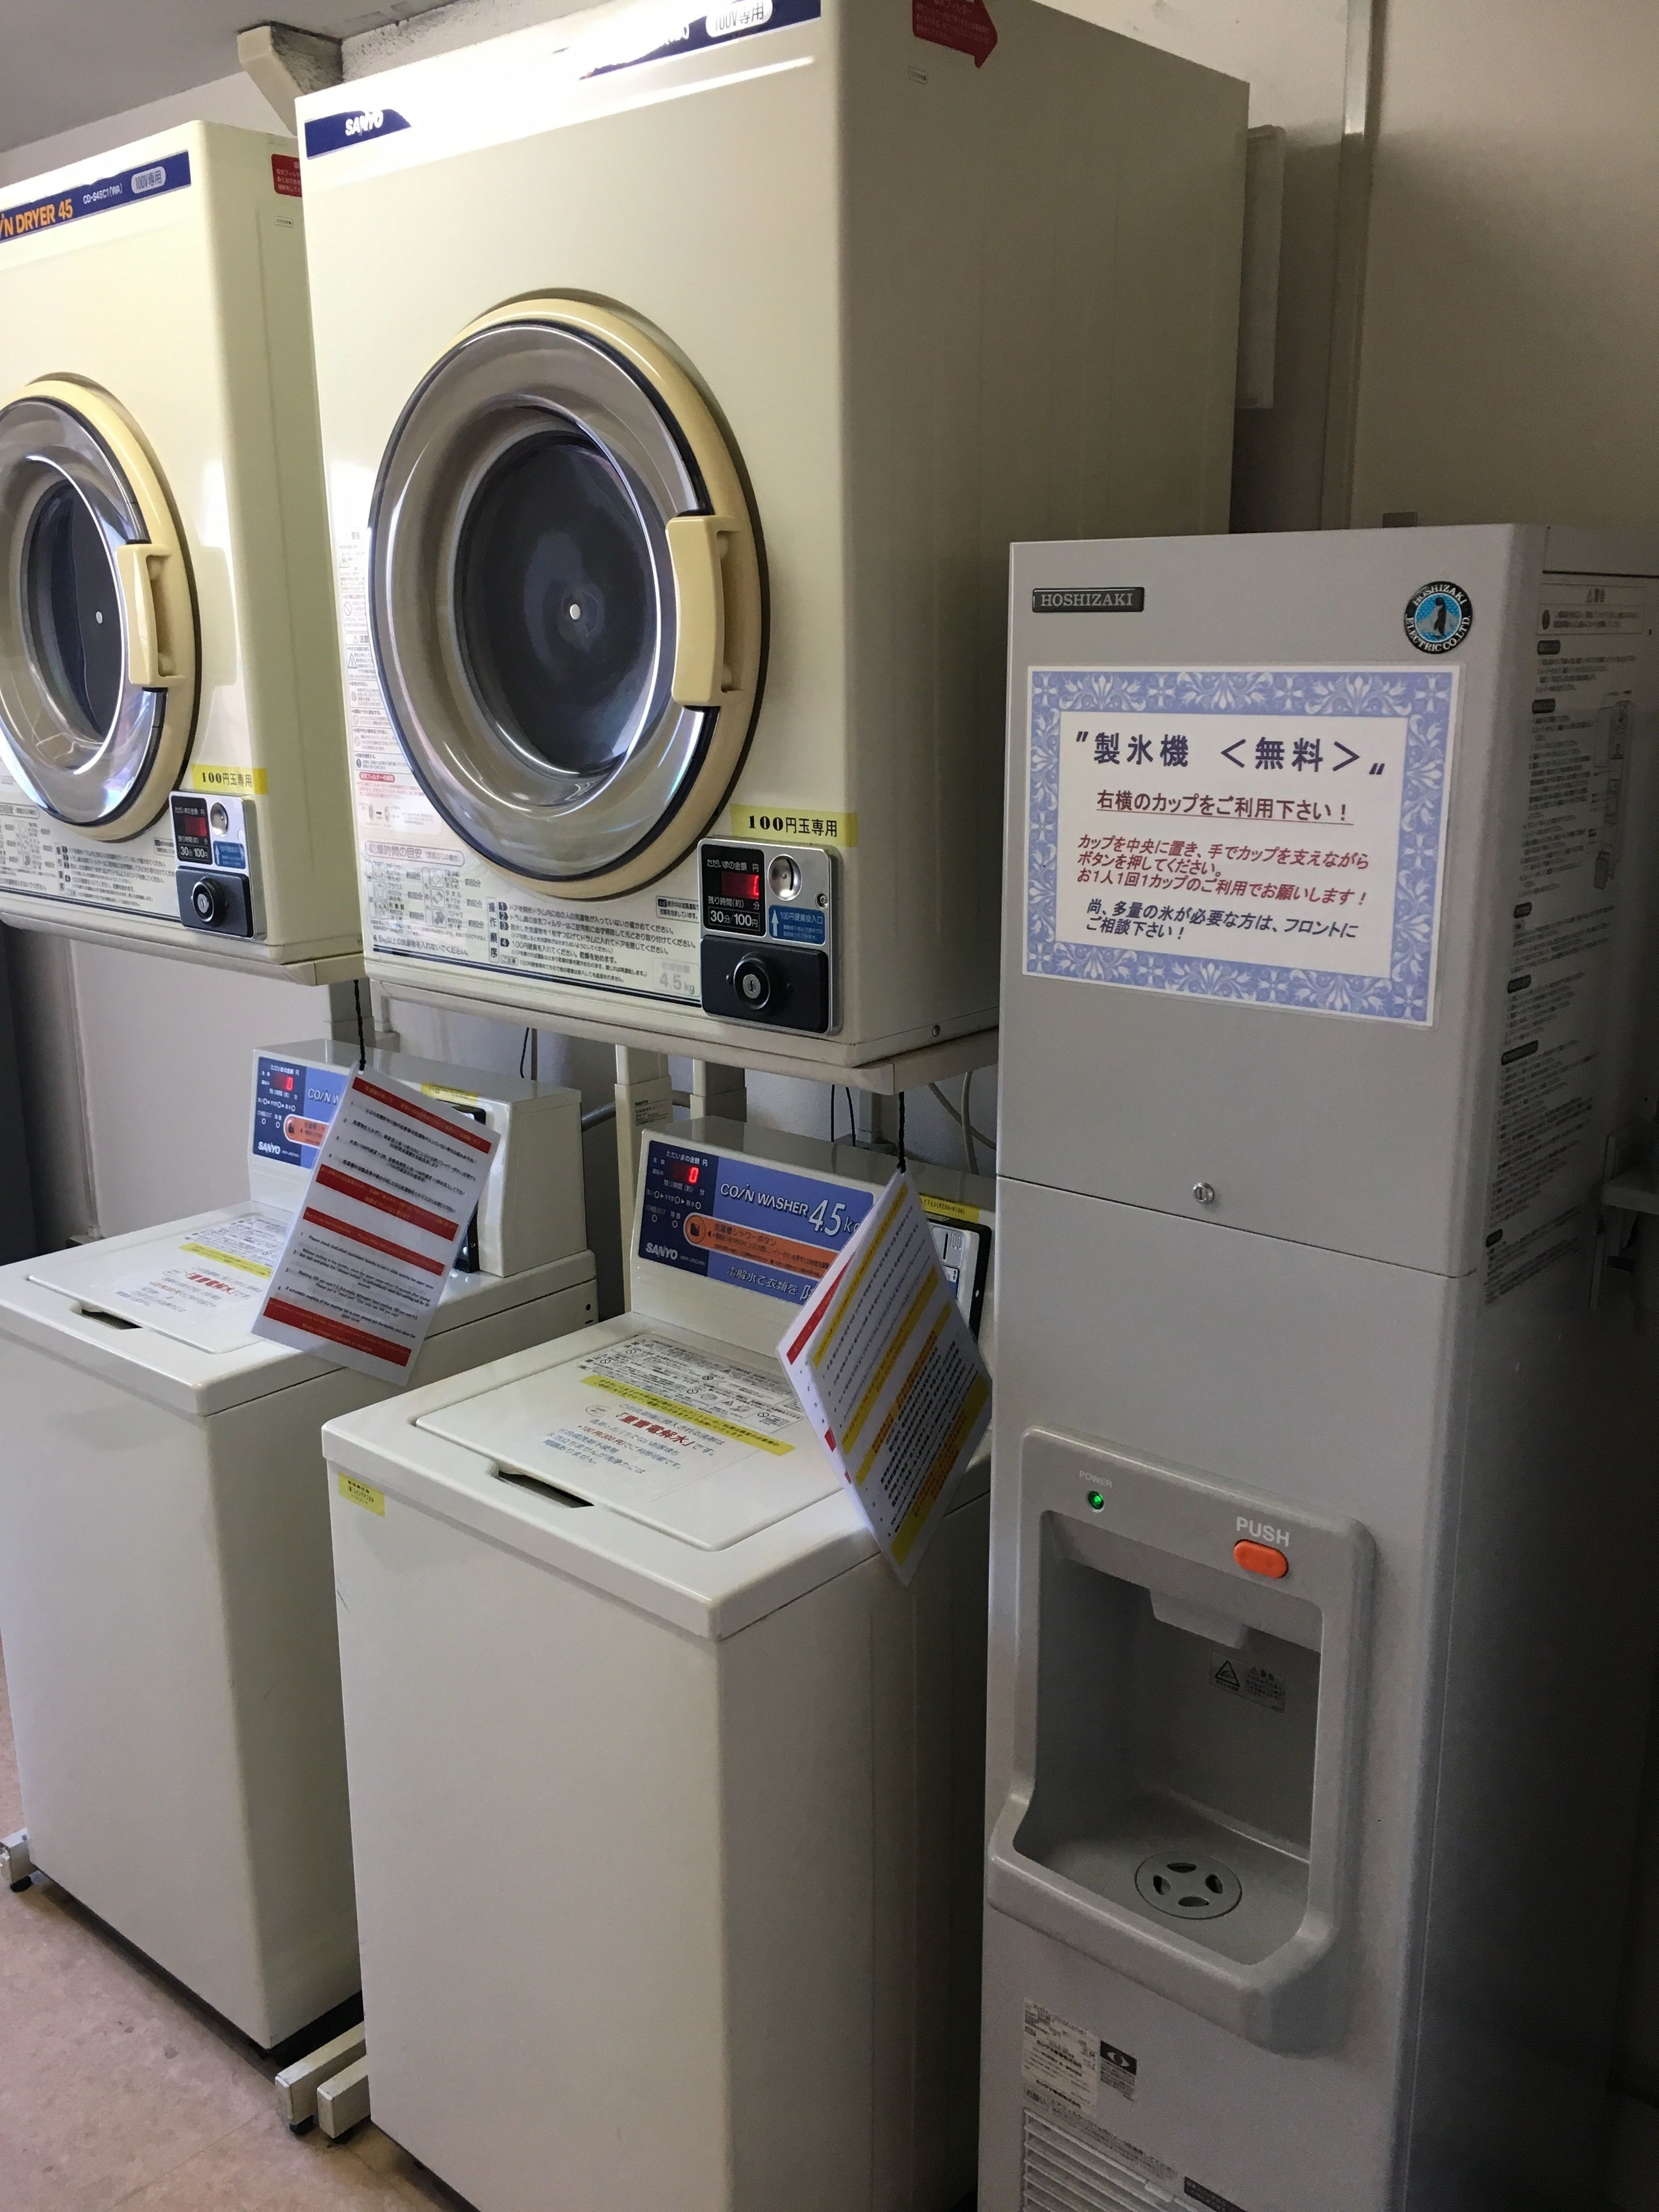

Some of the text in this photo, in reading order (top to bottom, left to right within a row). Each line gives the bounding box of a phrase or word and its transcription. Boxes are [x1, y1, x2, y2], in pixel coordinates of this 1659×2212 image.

[135, 169, 162, 190] 100V専用
[16, 203, 55, 234] DRYER
[58, 198, 73, 219] 45
[1040, 593, 1134, 608] HOSHIZAKI
[1413, 584, 1468, 605] HOSHIZAKI
[1406, 613, 1441, 652] ELECTRIC
[202, 772, 252, 787] 100円玉専用
[748, 815, 838, 838] 100円玉専用
[1078, 834, 1370, 870] カップを中央に置き、手でカップを支えながら
[707, 859, 759, 873] ただいまの金額 円
[1077, 852, 1223, 878] ボタンを押してください。
[753, 902, 760, 910] 分
[1087, 897, 1359, 939] 尚、多量の氷が必要な方は、フロントに
[1086, 918, 1185, 941] ご相談下さい！
[659, 972, 695, 994] 4.5 kg
[286, 1076, 294, 1091] 0
[258, 1141, 281, 1154] SANYO
[666, 1150, 708, 1167] ただいまの金額 円
[688, 1166, 699, 1183] 0
[757, 1192, 808, 1217] WASHER
[646, 1242, 678, 1260] SANYO
[1079, 1470, 1113, 1488] POWER
[1236, 1516, 1290, 1547] PUSH
